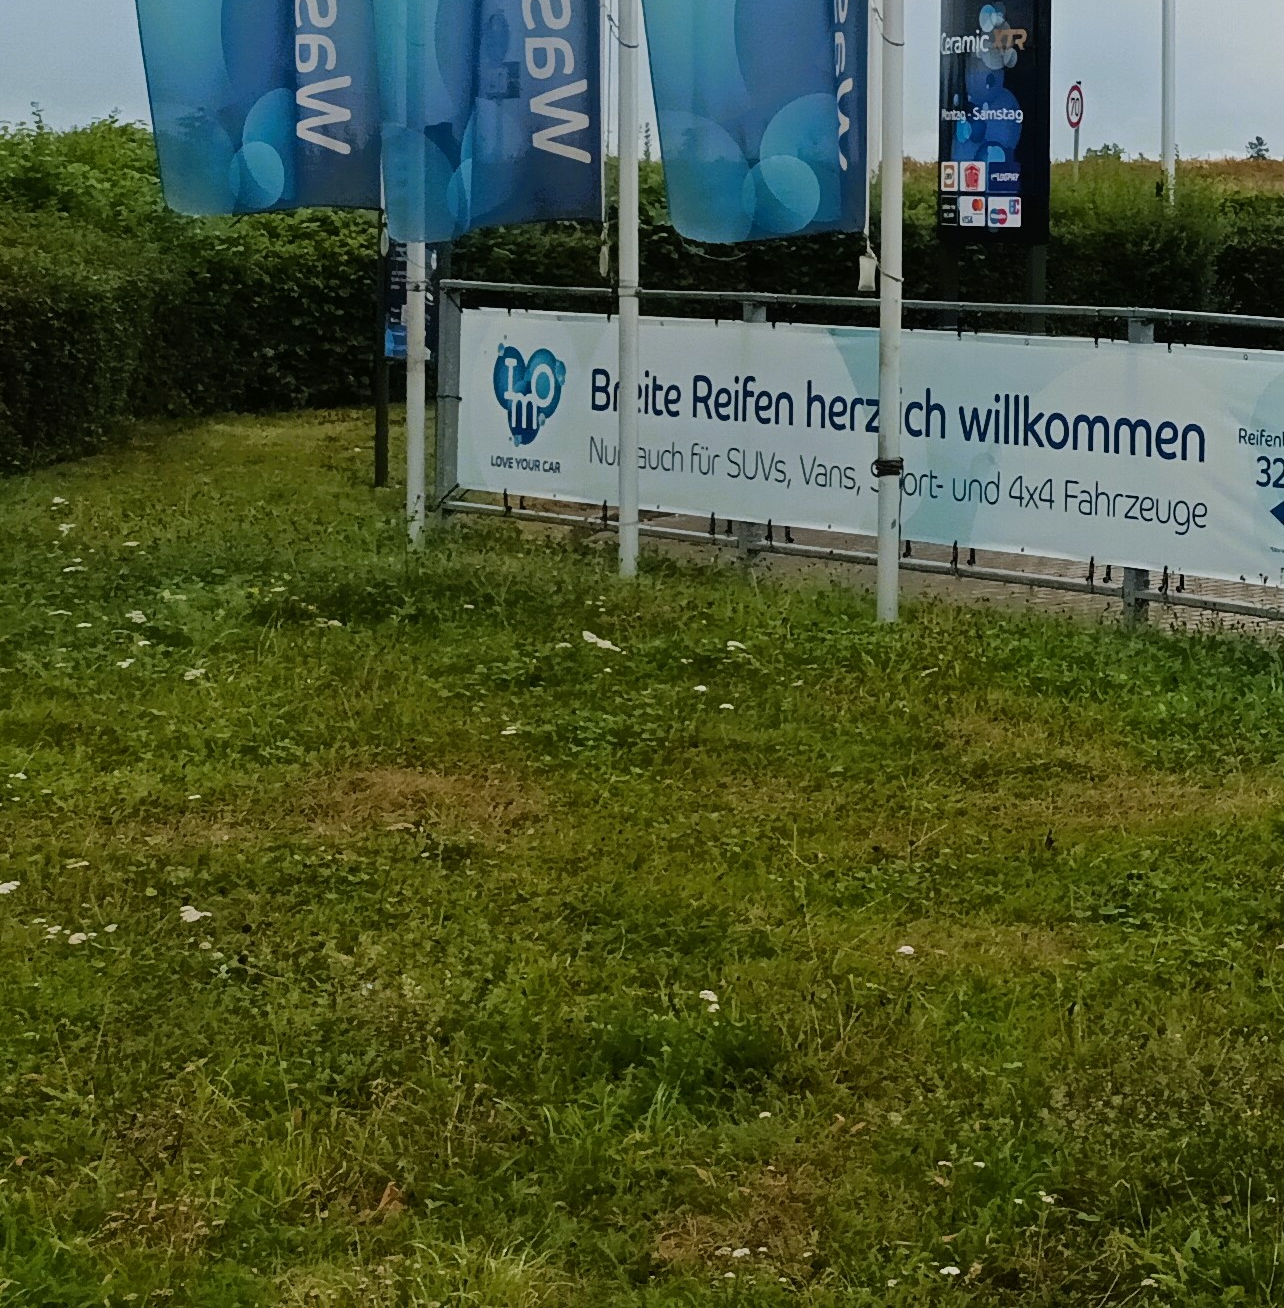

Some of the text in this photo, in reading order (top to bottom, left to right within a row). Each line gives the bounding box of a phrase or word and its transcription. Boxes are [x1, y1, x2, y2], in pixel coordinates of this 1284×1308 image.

[941, 30, 989, 55] Ceramic
[972, 107, 1024, 123] Samstag
[1070, 97, 1080, 117] 70
[692, 374, 794, 426] Reifen
[959, 393, 1205, 463] willkommen
[491, 455, 561, 473] LOVE YOUR CAR
[691, 442, 721, 475] für
[727, 448, 792, 489] SUVs,
[800, 455, 861, 496] Vans,
[953, 471, 1000, 505] und
[1009, 475, 1055, 510] 4x4
[1064, 480, 1208, 535] Fahrzeuge
